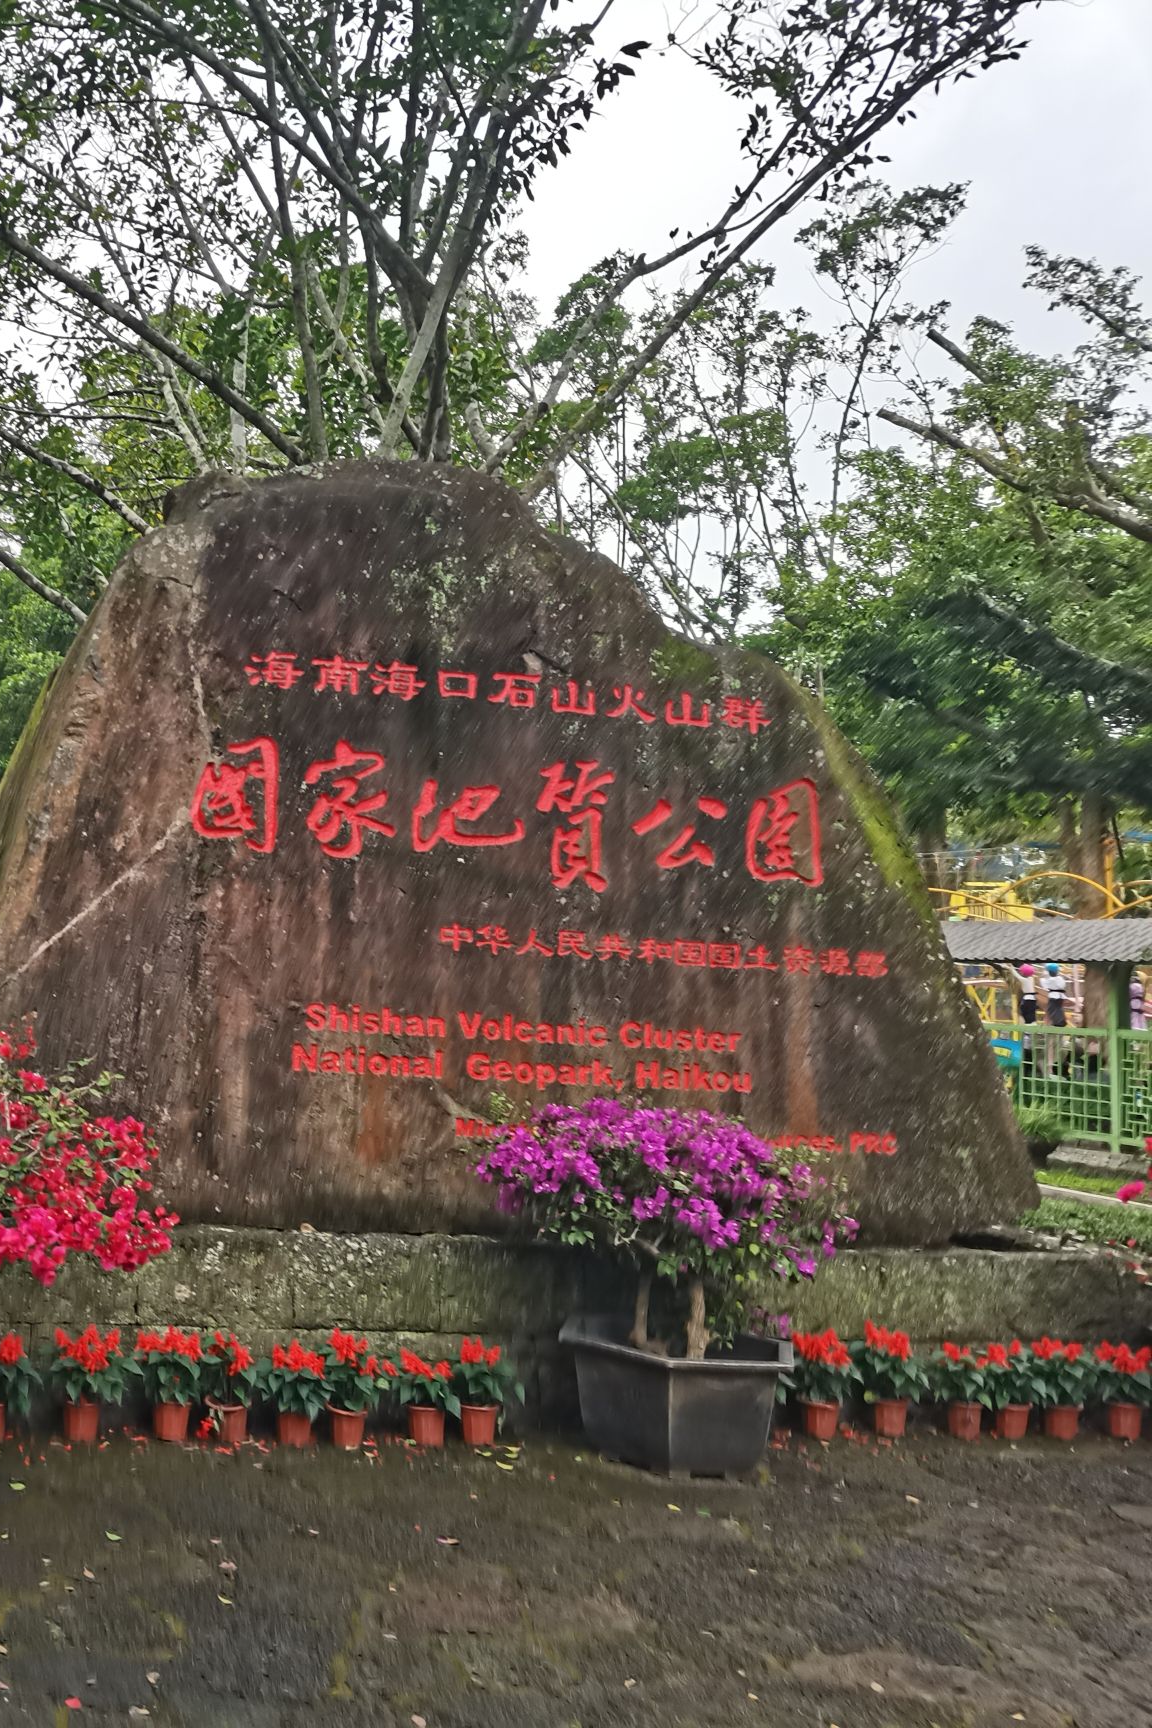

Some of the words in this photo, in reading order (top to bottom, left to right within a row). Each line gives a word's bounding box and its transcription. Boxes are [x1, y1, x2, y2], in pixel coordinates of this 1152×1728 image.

[244, 650, 771, 735] 海南海口石山火山群
[438, 922, 889, 978] 中华人民共和国国土资源部
[304, 1002, 447, 1039] Shishan
[457, 1010, 608, 1048] Volcanic
[619, 1021, 743, 1053] Cluster
[290, 1043, 444, 1079] National
[465, 1051, 625, 1092] Geopark,
[635, 1060, 753, 1094] Haikou
[849, 1131, 898, 1156] PRC
